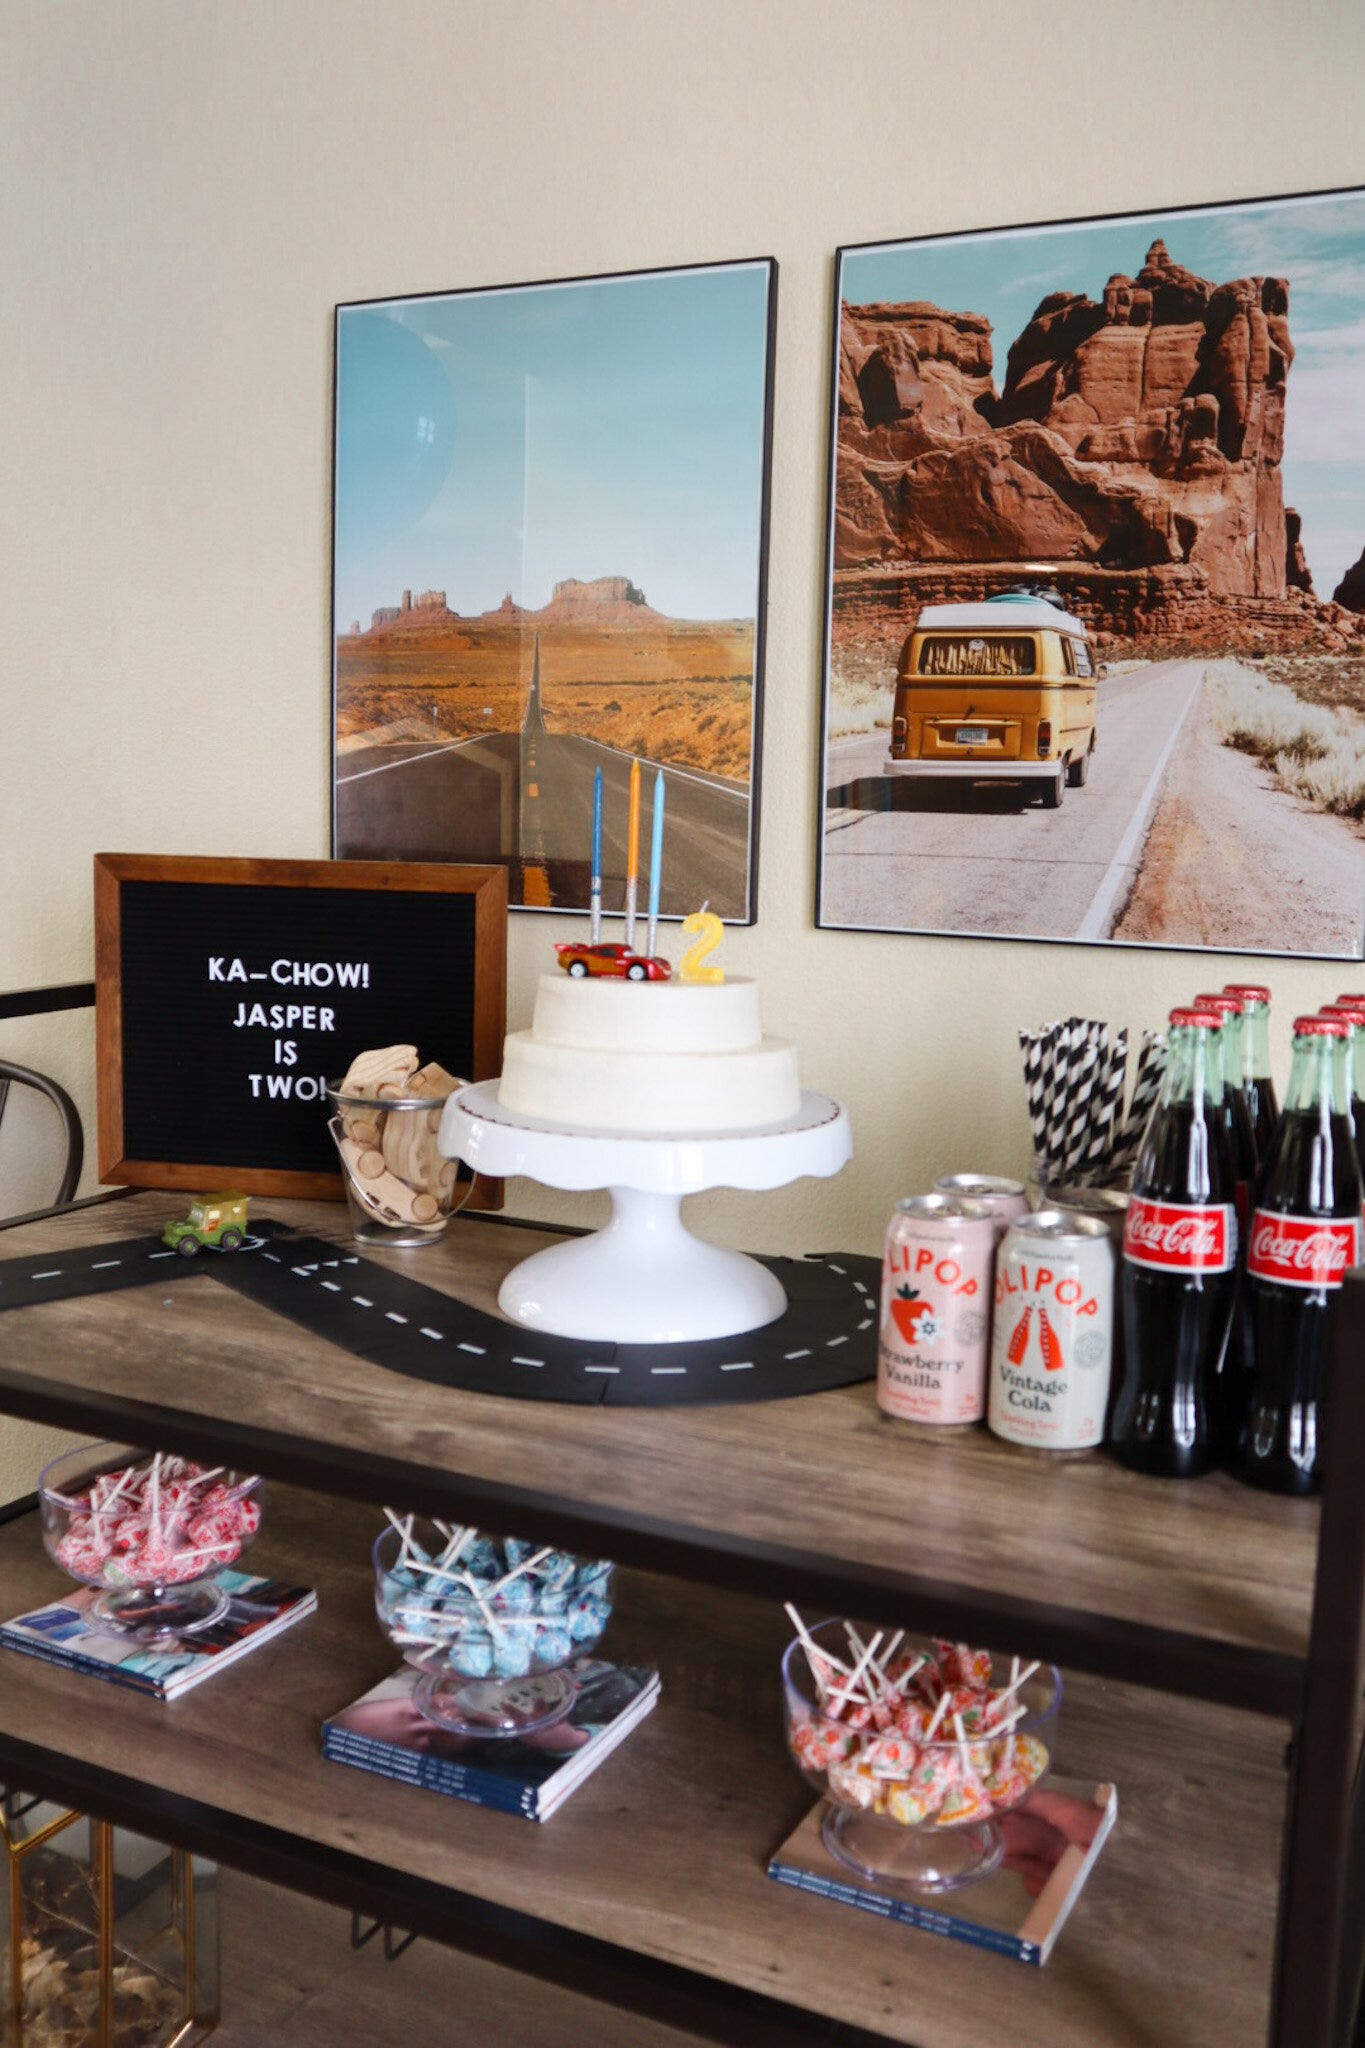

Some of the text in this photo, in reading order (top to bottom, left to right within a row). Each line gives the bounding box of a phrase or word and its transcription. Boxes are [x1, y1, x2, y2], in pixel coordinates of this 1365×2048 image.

[680, 912, 725, 984] 2
[208, 956, 370, 989] KA-CHOW!
[232, 1002, 335, 1032] JASPER
[274, 1039, 297, 1067] IS
[248, 1074, 327, 1101] TWO!
[1127, 1210, 1219, 1254] Coca-Cola
[1253, 1226, 1349, 1270] Coca-Cola
[883, 1244, 978, 1296] LIPOP
[885, 1361, 941, 1390] Vanilla
[1000, 1365, 1068, 1396] Vintage
[1008, 1389, 1052, 1413] Cola
